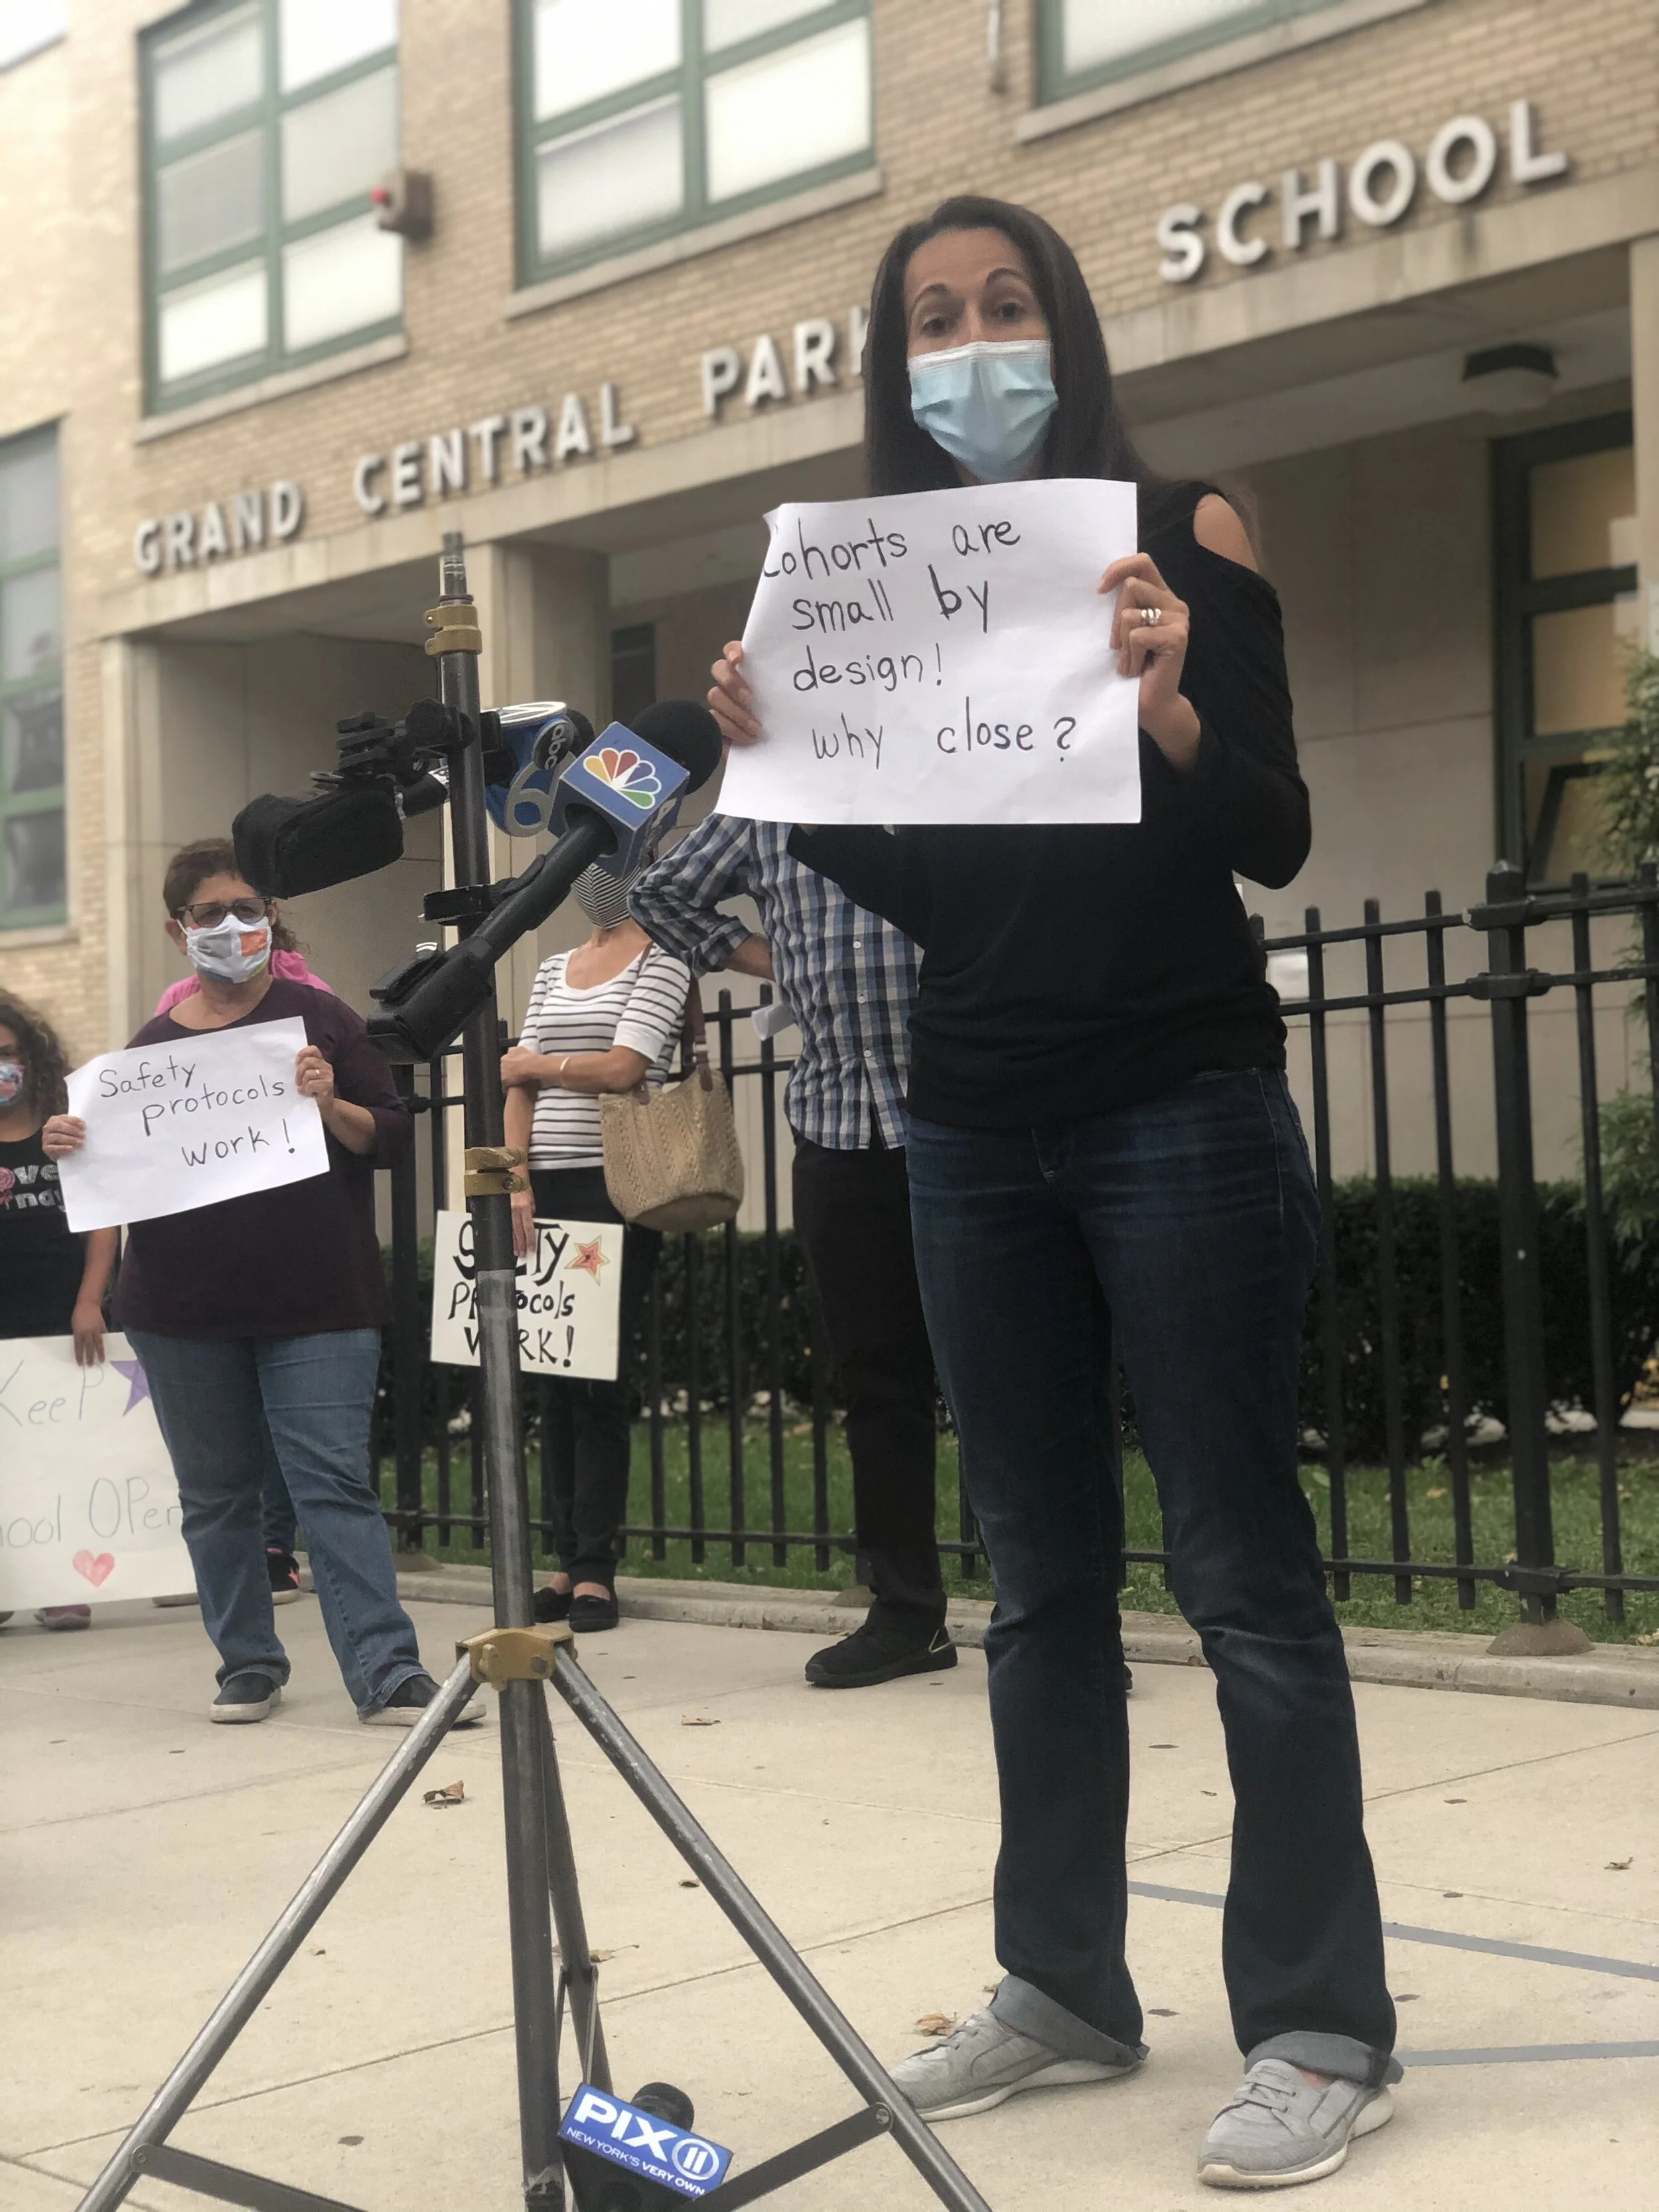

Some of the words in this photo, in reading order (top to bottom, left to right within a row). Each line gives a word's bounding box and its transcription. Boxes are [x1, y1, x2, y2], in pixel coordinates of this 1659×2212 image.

[133, 480, 303, 573] GRAND
[353, 382, 636, 516] CENTRAL
[1157, 98, 1568, 283] SCHOOL
[952, 520, 1021, 556] are
[792, 577, 894, 634] small
[928, 564, 989, 634] by
[793, 642, 942, 692] design!
[544, 724, 566, 771] abc
[812, 711, 884, 770] why
[98, 1055, 196, 1098] Safety
[141, 1074, 285, 1137] protocols
[180, 1118, 296, 1167] work!
[567, 2126, 596, 2146] NEW
[597, 2139, 640, 2167] YORK'S
[642, 2161, 678, 2184] VERY
[674, 2177, 705, 2196] OWN
[574, 2093, 678, 2162] PIX
[683, 2146, 708, 2174] 11
